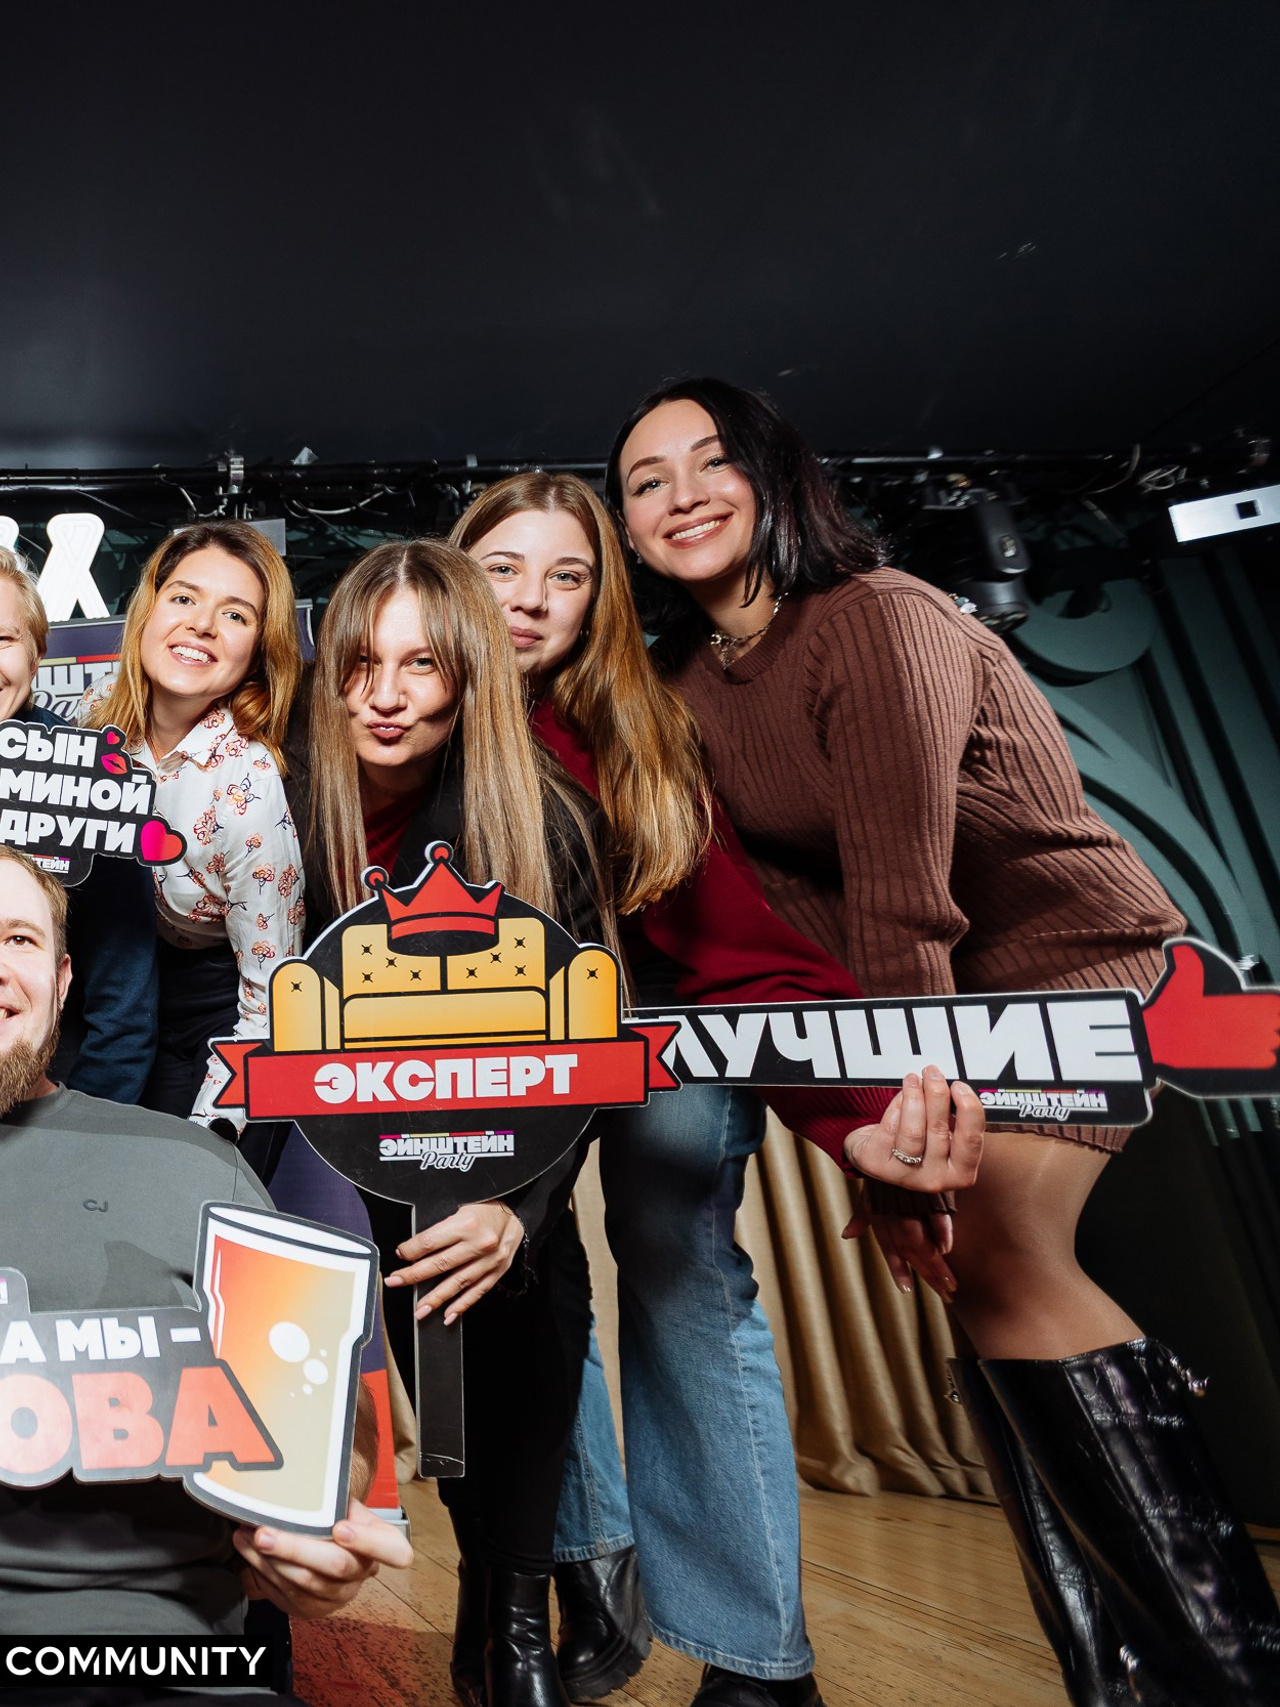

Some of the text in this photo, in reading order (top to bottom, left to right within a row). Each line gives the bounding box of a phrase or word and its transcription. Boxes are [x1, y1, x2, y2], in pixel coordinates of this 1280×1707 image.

[659, 1000, 1142, 1080] ЛУЧШИЕ
[314, 1054, 577, 1103] ЭКСПЕРТ
[980, 1089, 1108, 1108] ЭЙНШТЕЙН
[1019, 1103, 1070, 1120] Party
[379, 1131, 514, 1156] ЭЙНШТЕЙН
[420, 1150, 475, 1172] Party
[0, 1321, 46, 1364] А
[56, 1316, 160, 1361] МЫ
